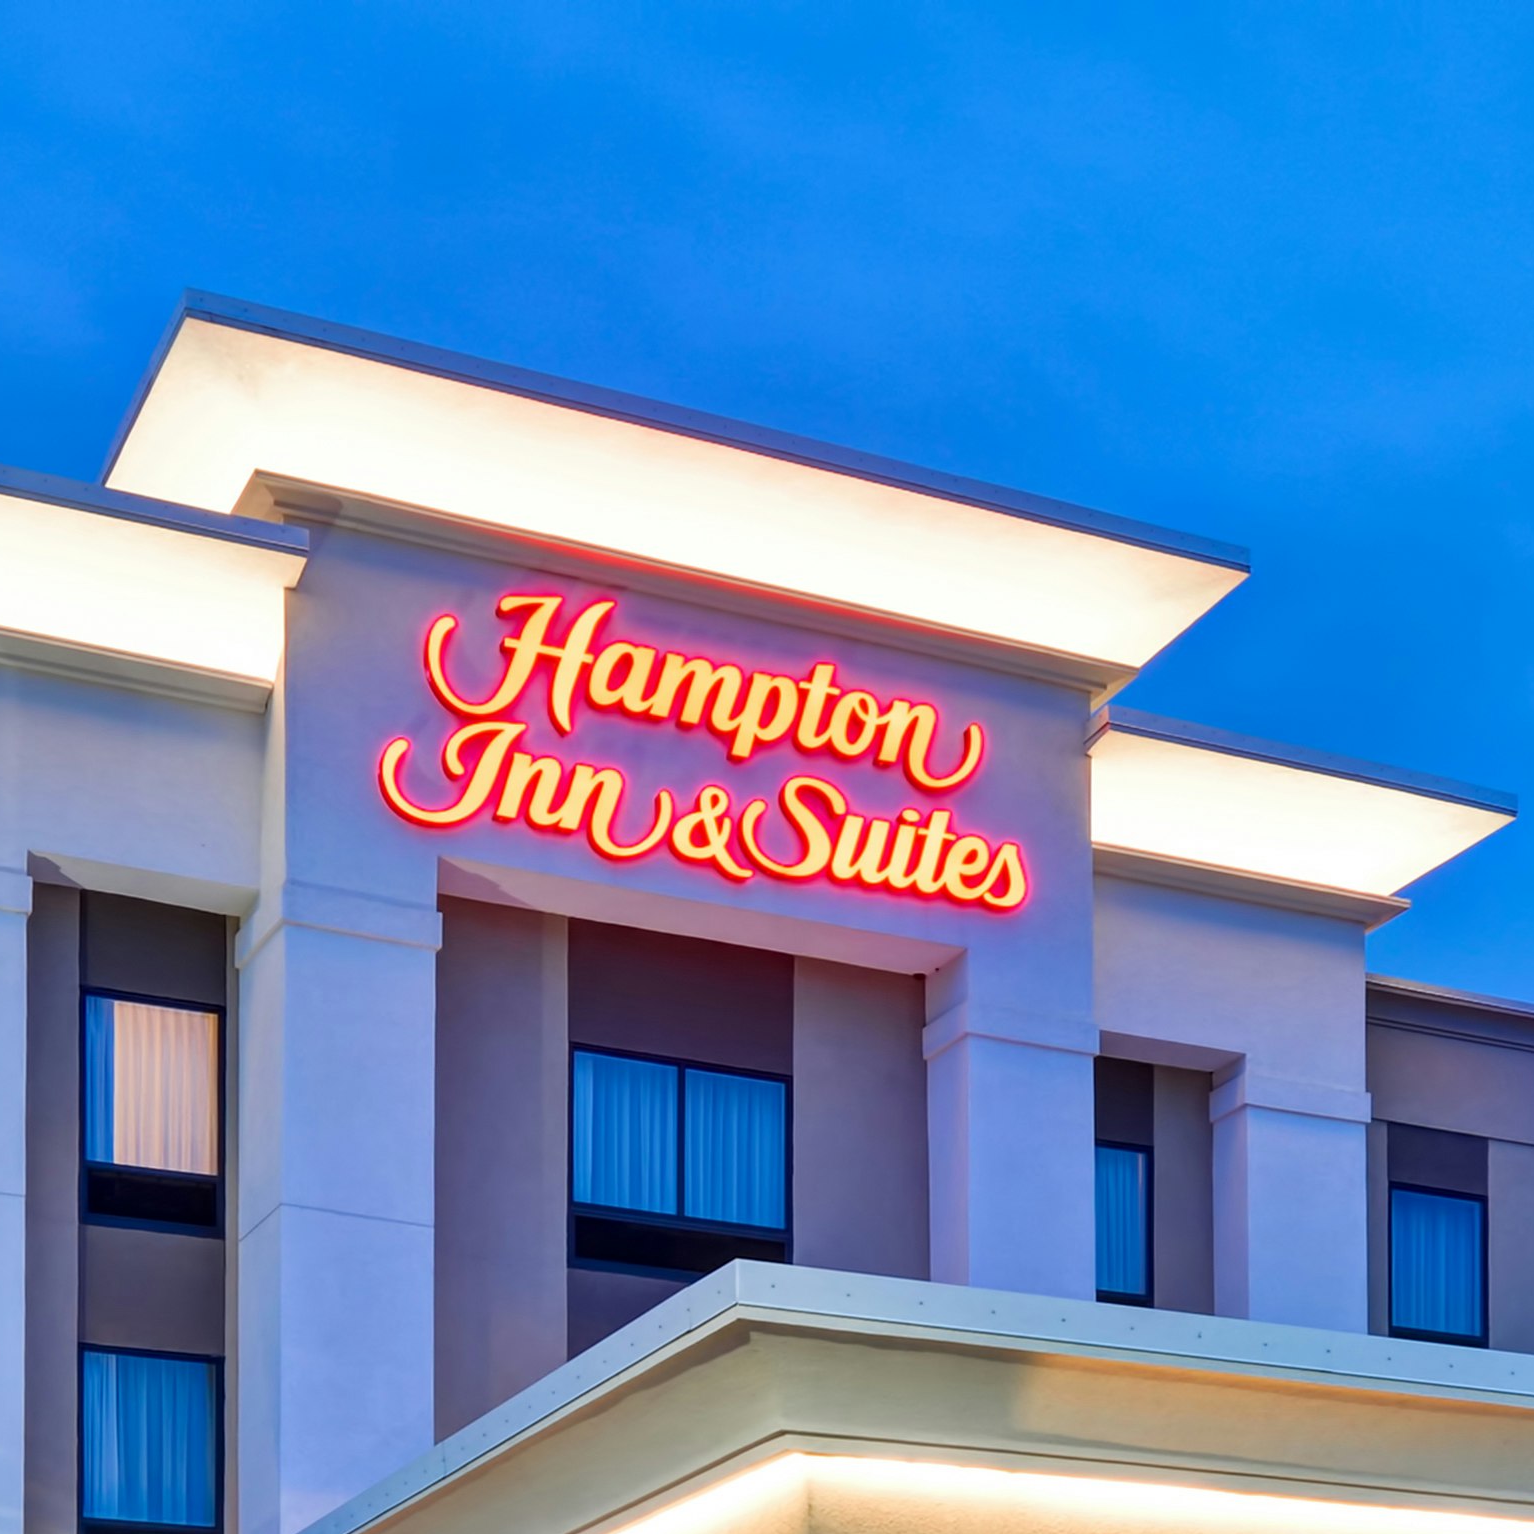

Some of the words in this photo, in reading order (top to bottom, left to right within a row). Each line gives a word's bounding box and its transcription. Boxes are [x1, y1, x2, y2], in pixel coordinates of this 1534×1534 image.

[424, 595, 984, 796] Hampton
[378, 721, 673, 862] Inn
[669, 784, 753, 882] &
[741, 774, 1027, 912] Suites
